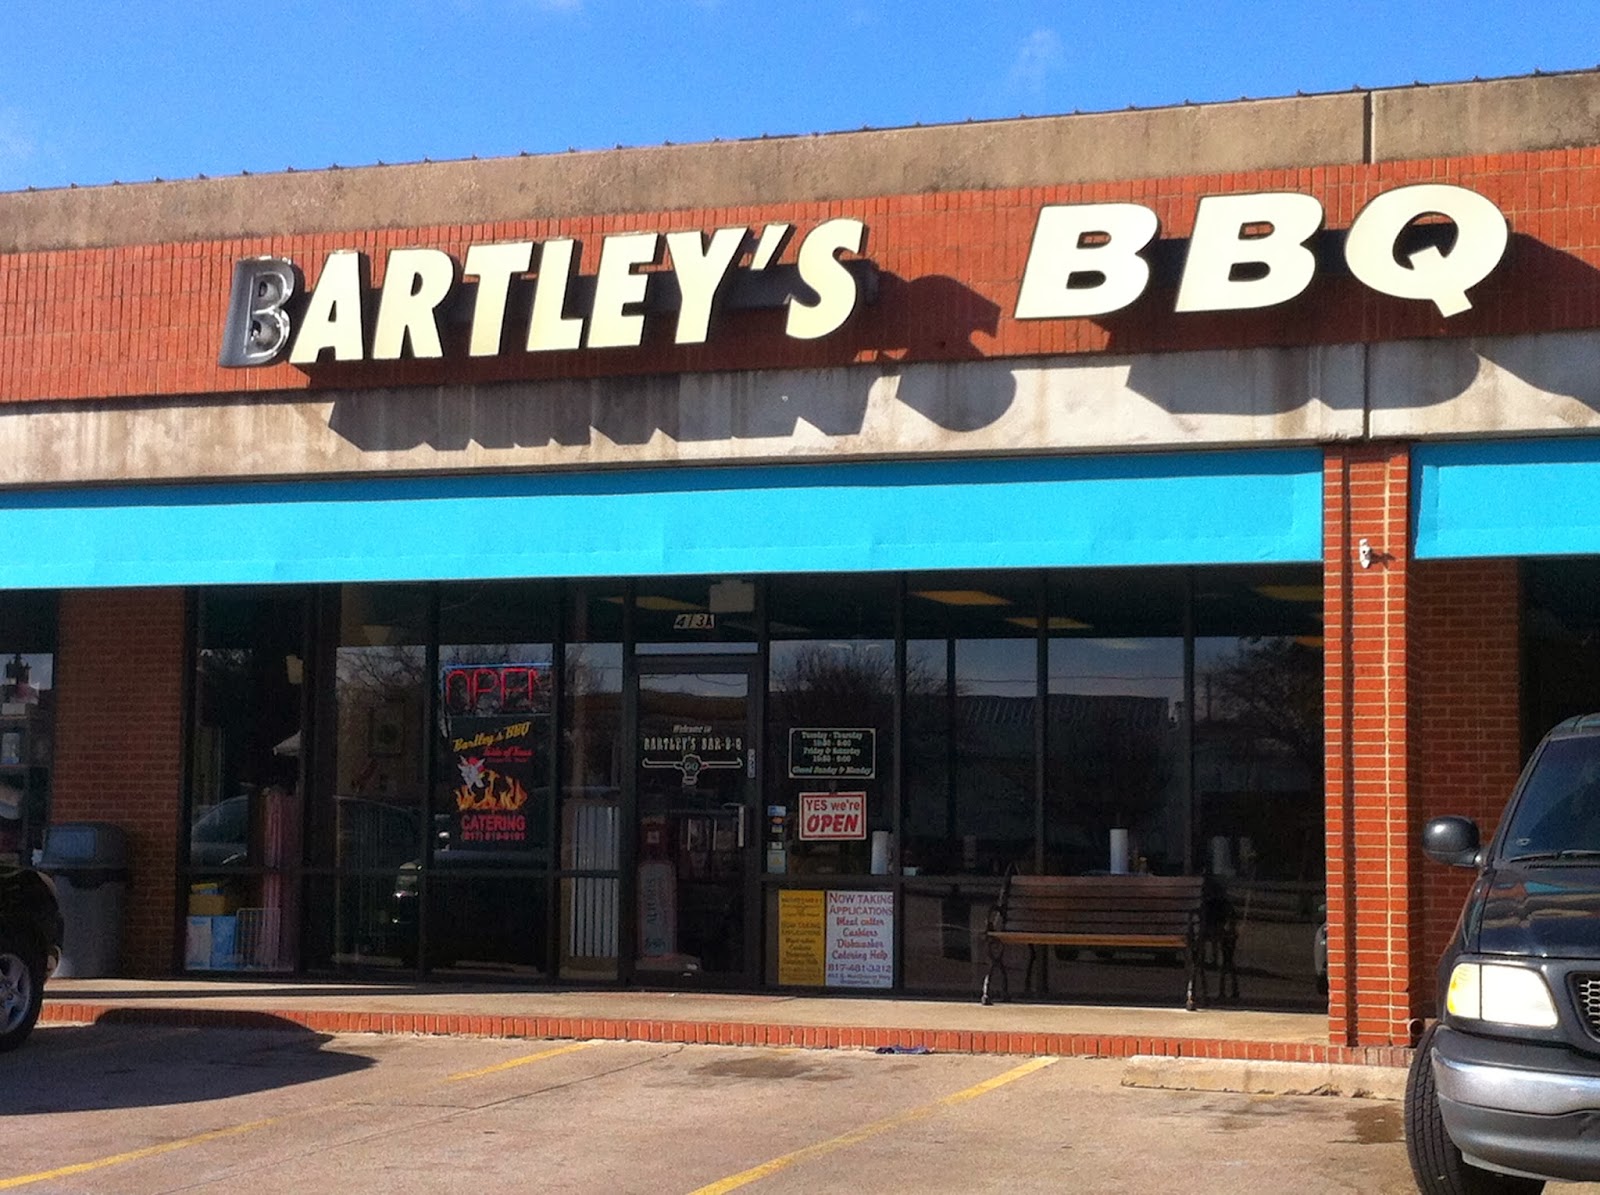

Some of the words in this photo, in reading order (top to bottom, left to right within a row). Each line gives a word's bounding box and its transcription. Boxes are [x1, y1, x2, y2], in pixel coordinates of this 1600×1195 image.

[219, 217, 865, 368] BARTLEY'S
[1013, 183, 1509, 318] BBQ
[505, 720, 532, 739] BBQ
[643, 736, 696, 751] BARTLEY'S
[701, 736, 742, 751] BAR-B-Q
[806, 799, 828, 811] YES
[831, 799, 861, 811] we're
[461, 814, 526, 831] CATERING
[807, 814, 859, 833] OPEN
[829, 892, 856, 904] NOW
[829, 905, 893, 916] APPLICATIONS
[836, 916, 858, 926] Meat
[842, 927, 878, 937] Cashiers
[832, 950, 868, 961] Catering
[870, 949, 889, 961] Help
